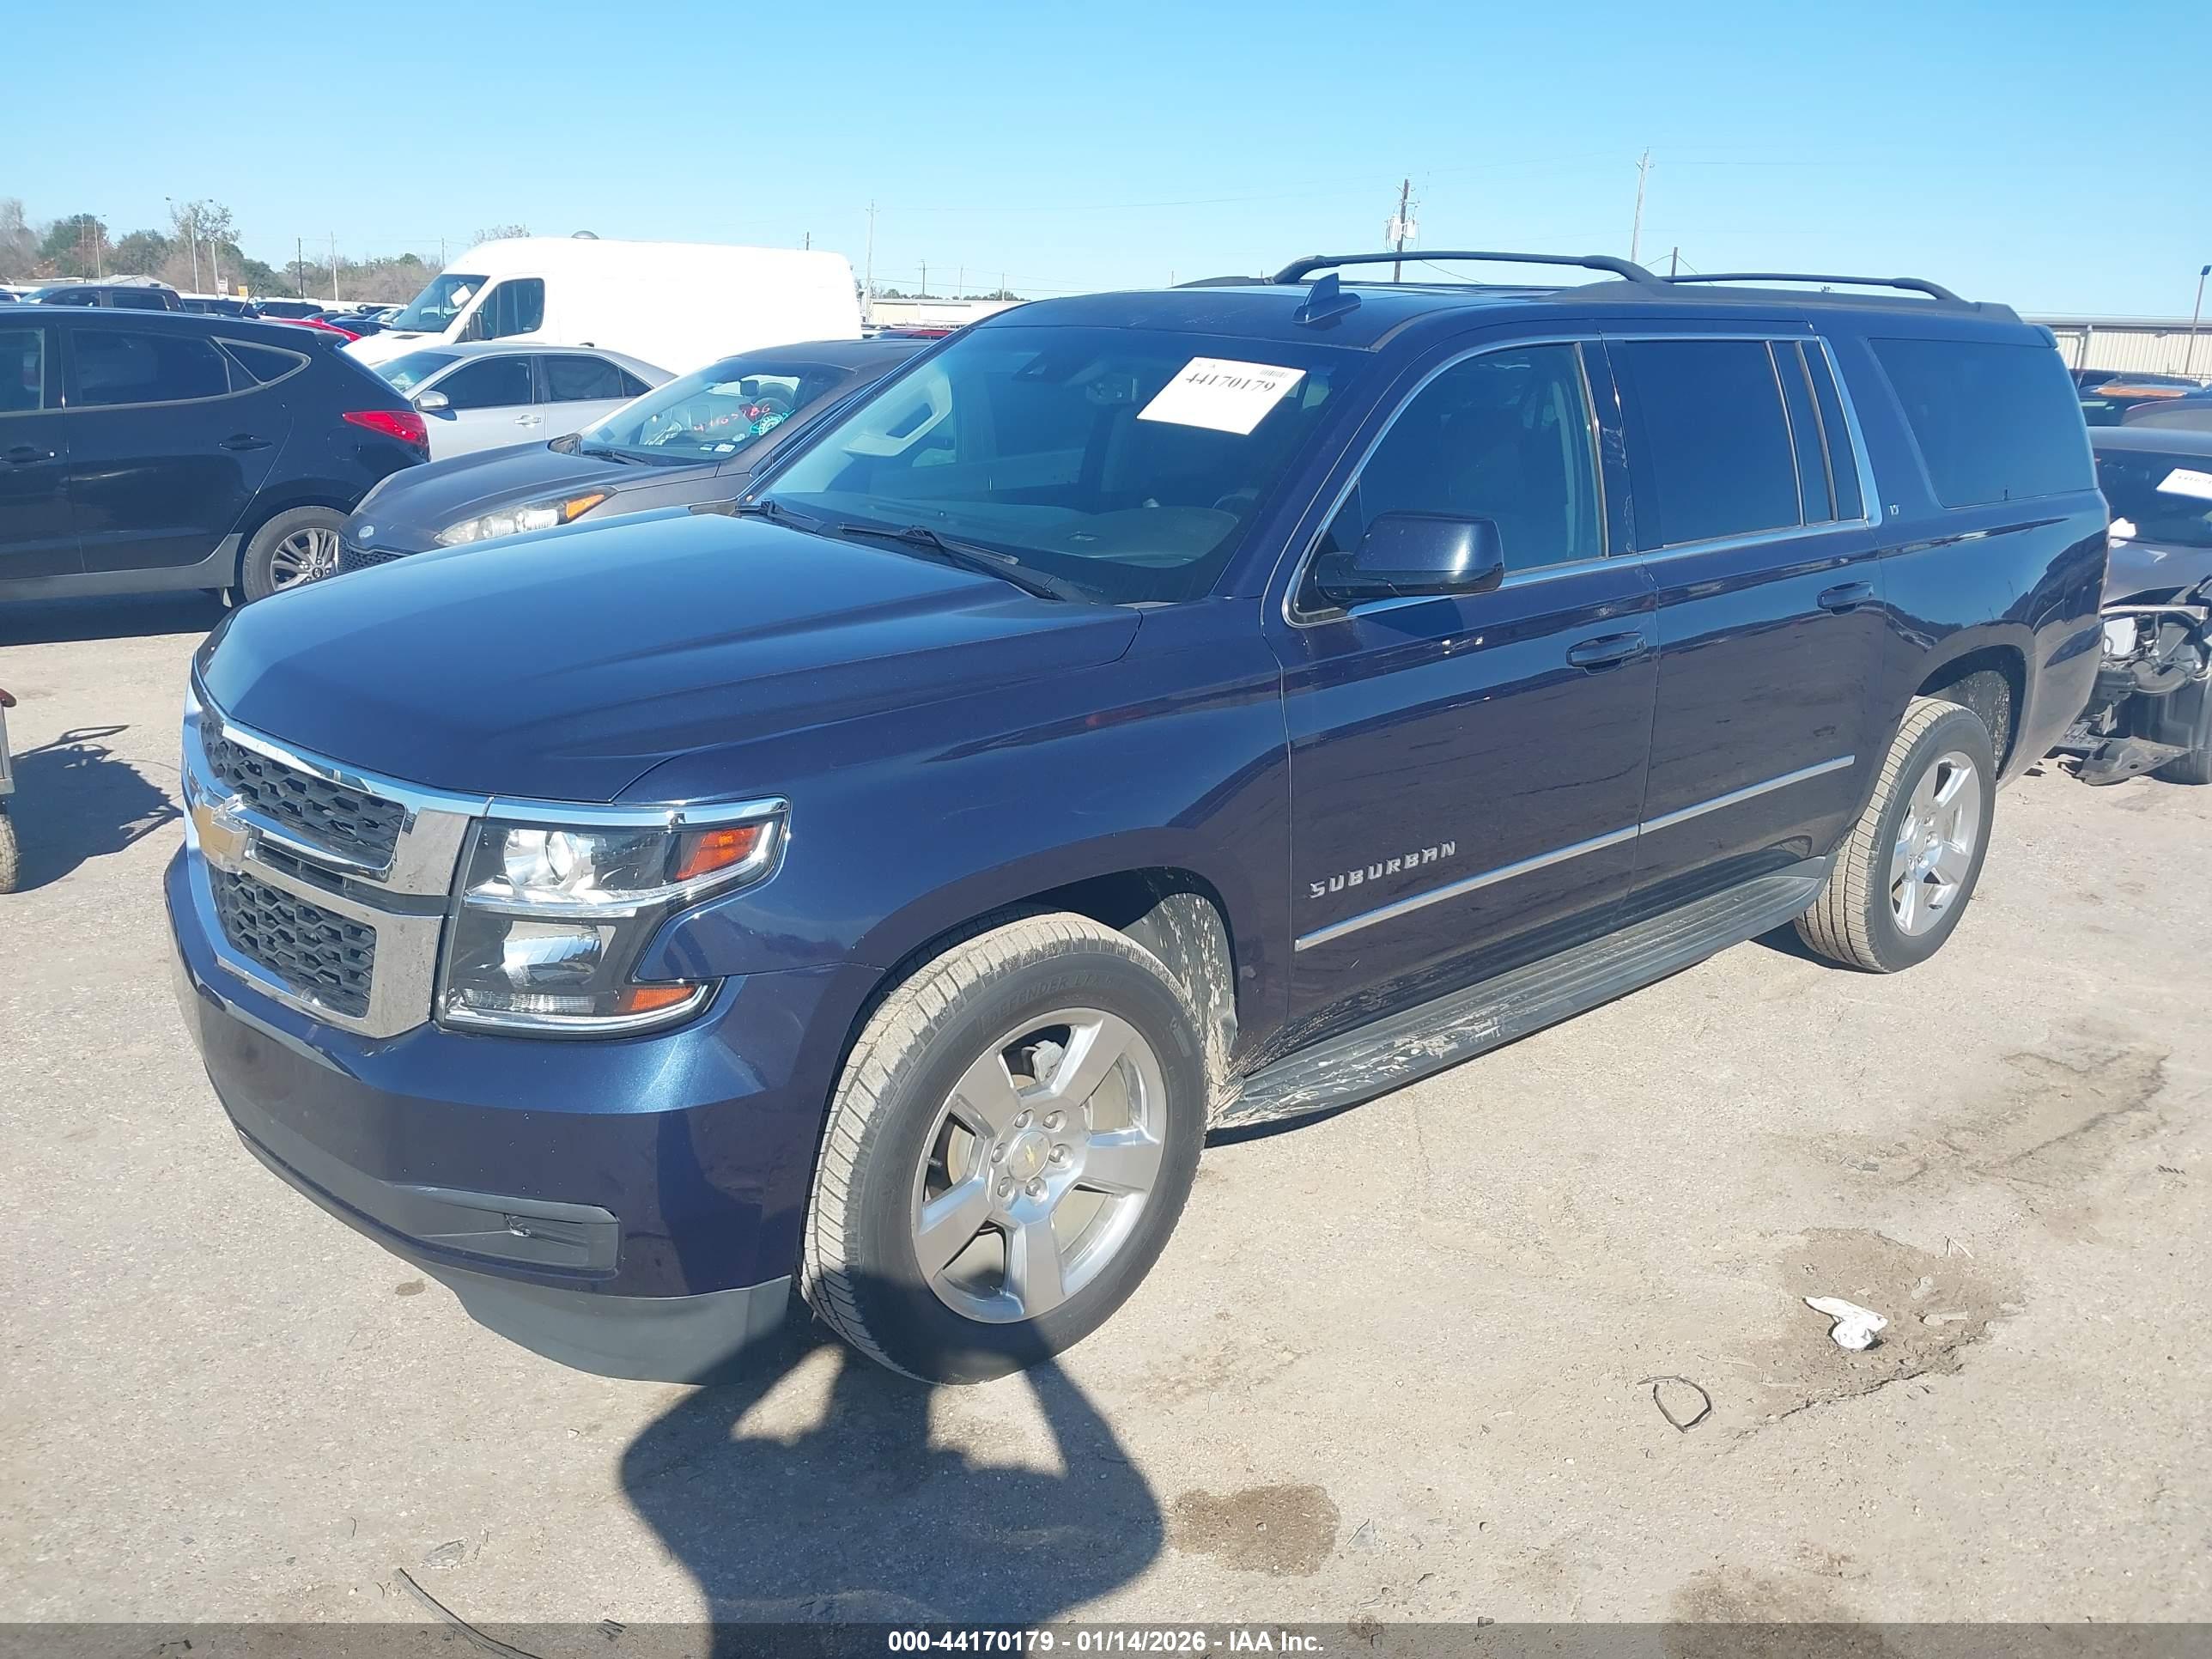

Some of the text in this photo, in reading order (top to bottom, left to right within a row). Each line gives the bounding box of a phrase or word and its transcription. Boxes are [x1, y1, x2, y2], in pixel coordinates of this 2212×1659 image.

[1186, 373, 1276, 392] 44170179
[1310, 840, 1456, 898] SUBURBAN
[988, 976, 1067, 1024] DEFENDER
